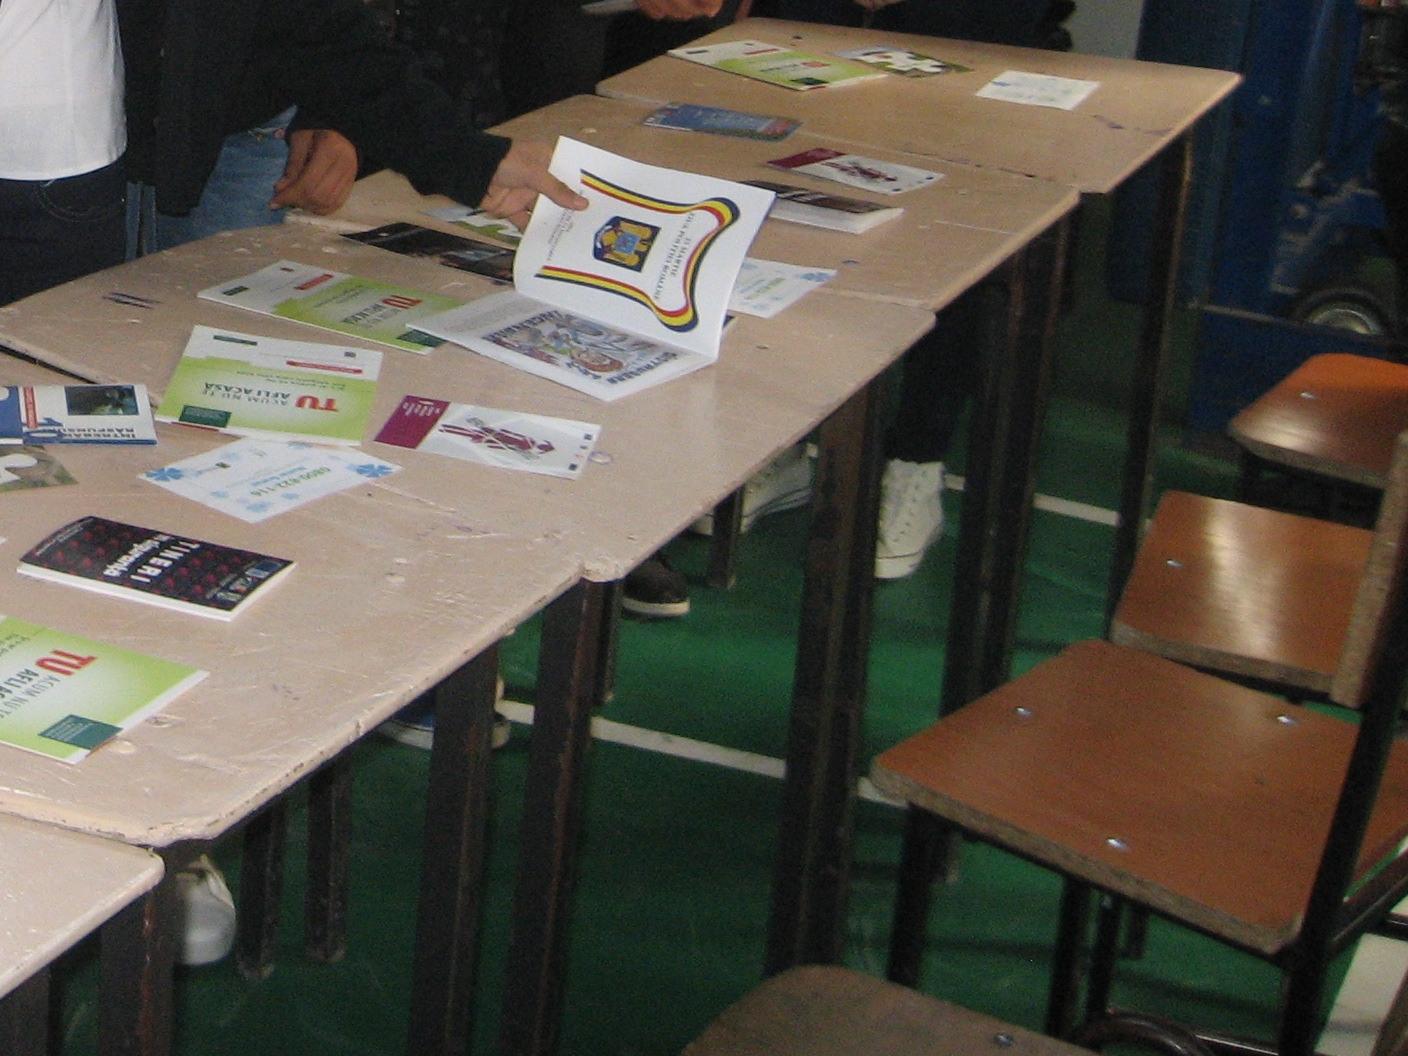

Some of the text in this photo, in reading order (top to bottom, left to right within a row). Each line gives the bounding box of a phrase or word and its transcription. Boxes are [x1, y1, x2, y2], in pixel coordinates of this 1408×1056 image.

[256, 388, 291, 400] AFLI
[295, 394, 339, 413] TU
[130, 540, 201, 584] TINERI
[34, 648, 99, 677] TU
[3, 667, 41, 689] AFLI
[22, 674, 61, 698] ACUM
[4, 695, 29, 710] NU
